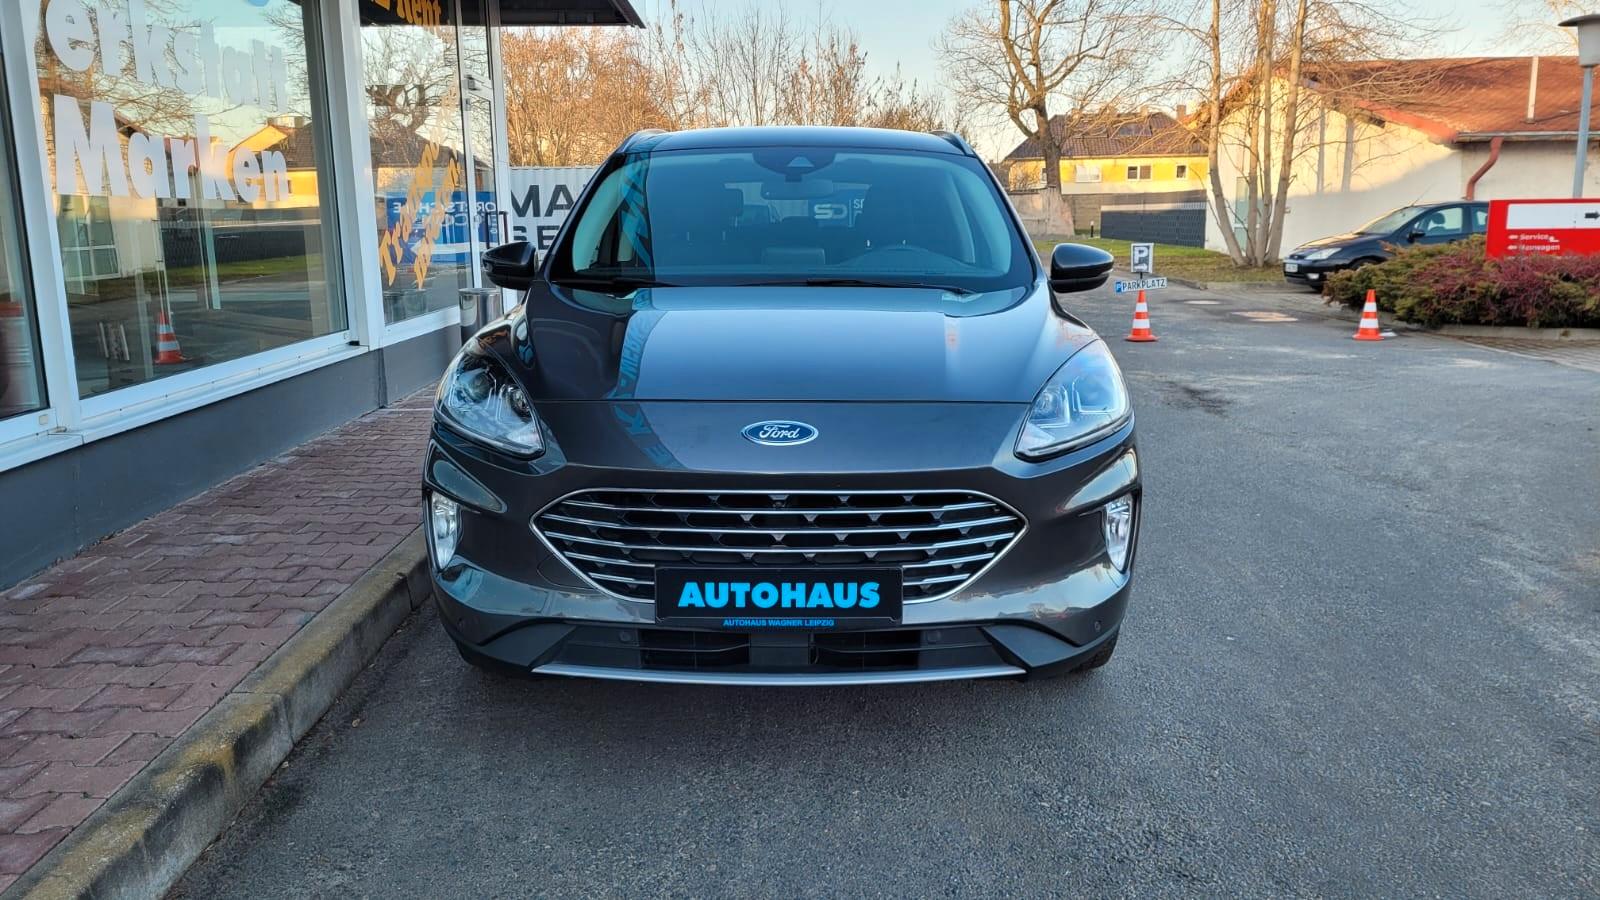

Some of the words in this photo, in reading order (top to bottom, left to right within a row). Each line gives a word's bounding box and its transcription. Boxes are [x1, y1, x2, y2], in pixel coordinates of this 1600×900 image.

[54, 94, 287, 203] Marken
[1134, 247, 1148, 263] P
[1122, 279, 1165, 290] PARKPLATZ
[758, 424, 800, 440] Ford
[678, 582, 880, 608] AUTOHAUS
[723, 618, 766, 627] AUTOHAUS
[768, 618, 803, 627] WAGNER
[804, 618, 835, 627] LEIPZIG
